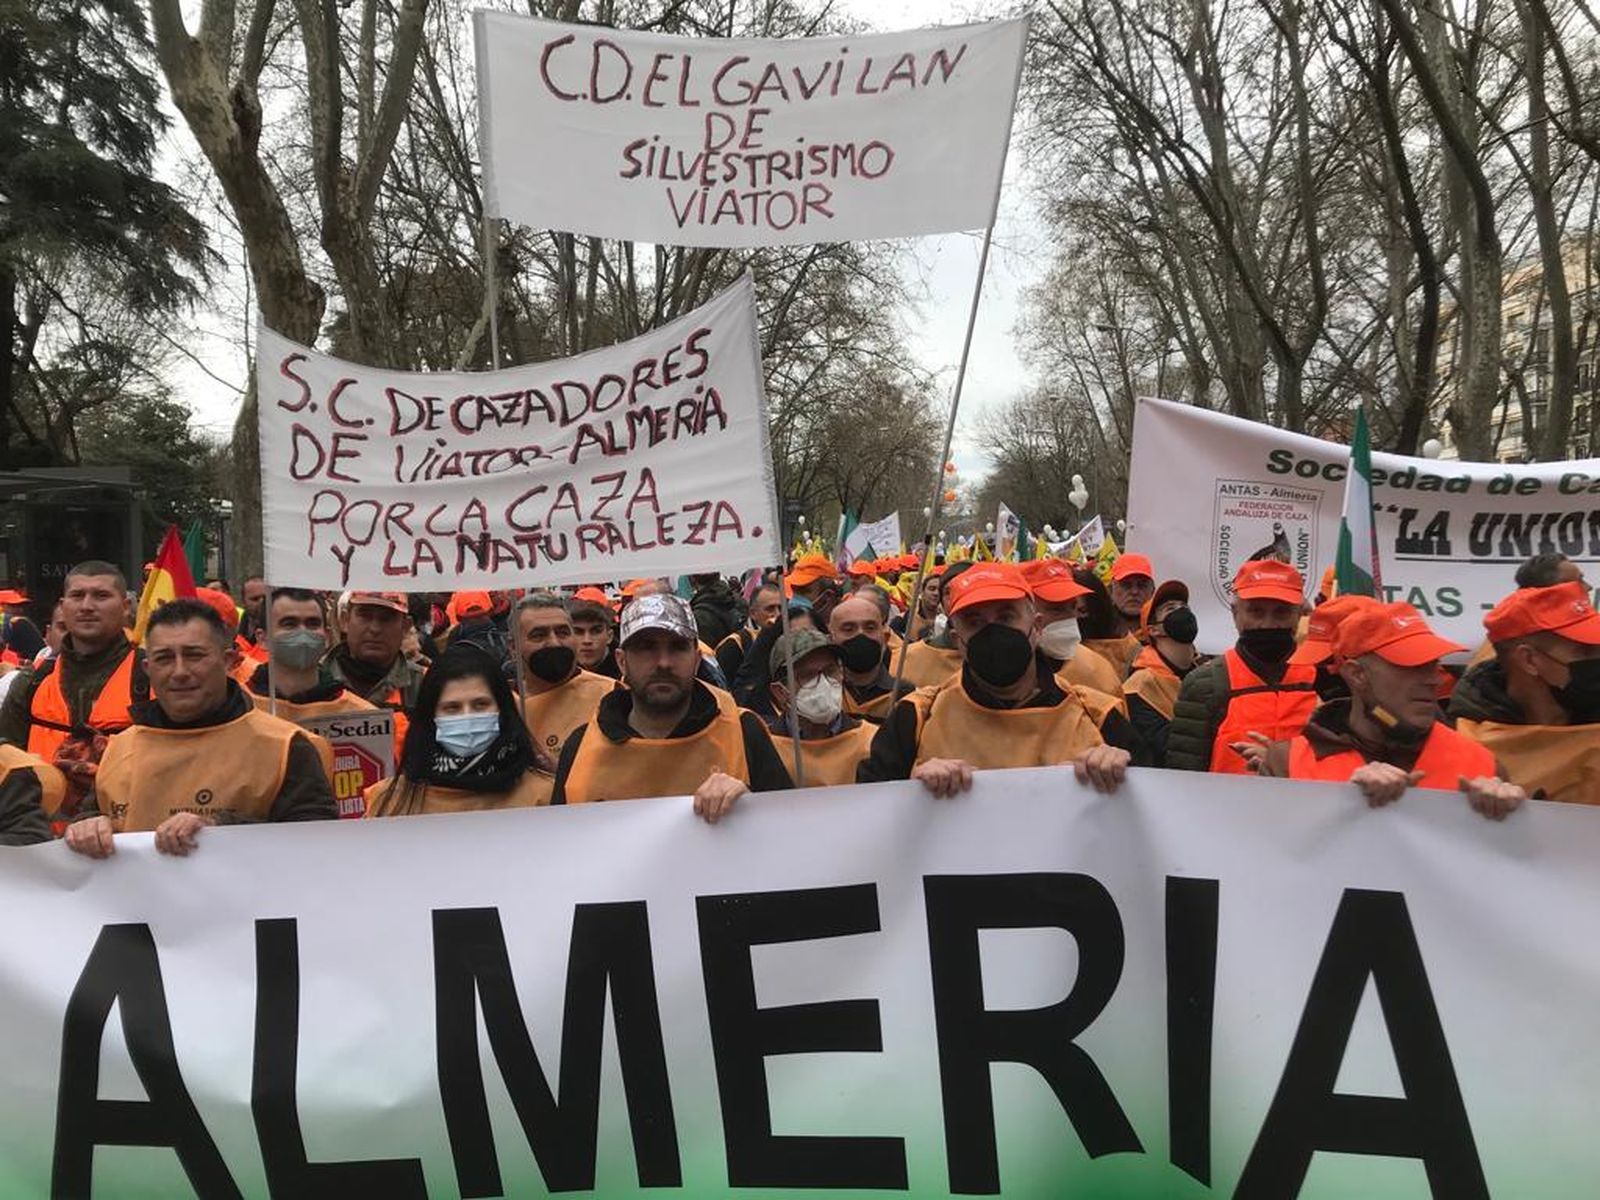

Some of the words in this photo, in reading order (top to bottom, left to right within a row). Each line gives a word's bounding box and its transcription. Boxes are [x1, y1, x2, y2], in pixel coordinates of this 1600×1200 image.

[704, 109, 771, 152] DE
[289, 423, 369, 483] DE
[1266, 449, 1472, 495] Socedad
[1486, 472, 1542, 495] de
[308, 488, 415, 557] POR
[504, 466, 661, 533] CAZA
[1219, 484, 1261, 496] ANTAS
[1271, 511, 1282, 520] DE
[1285, 512, 1309, 521] CAZA
[330, 542, 356, 588] Y
[383, 536, 444, 577] LA
[1382, 585, 1464, 618] TAS
[329, 719, 391, 739] Sedal
[334, 770, 364, 800] OP
[50, 872, 1492, 1200] ALMERIA
